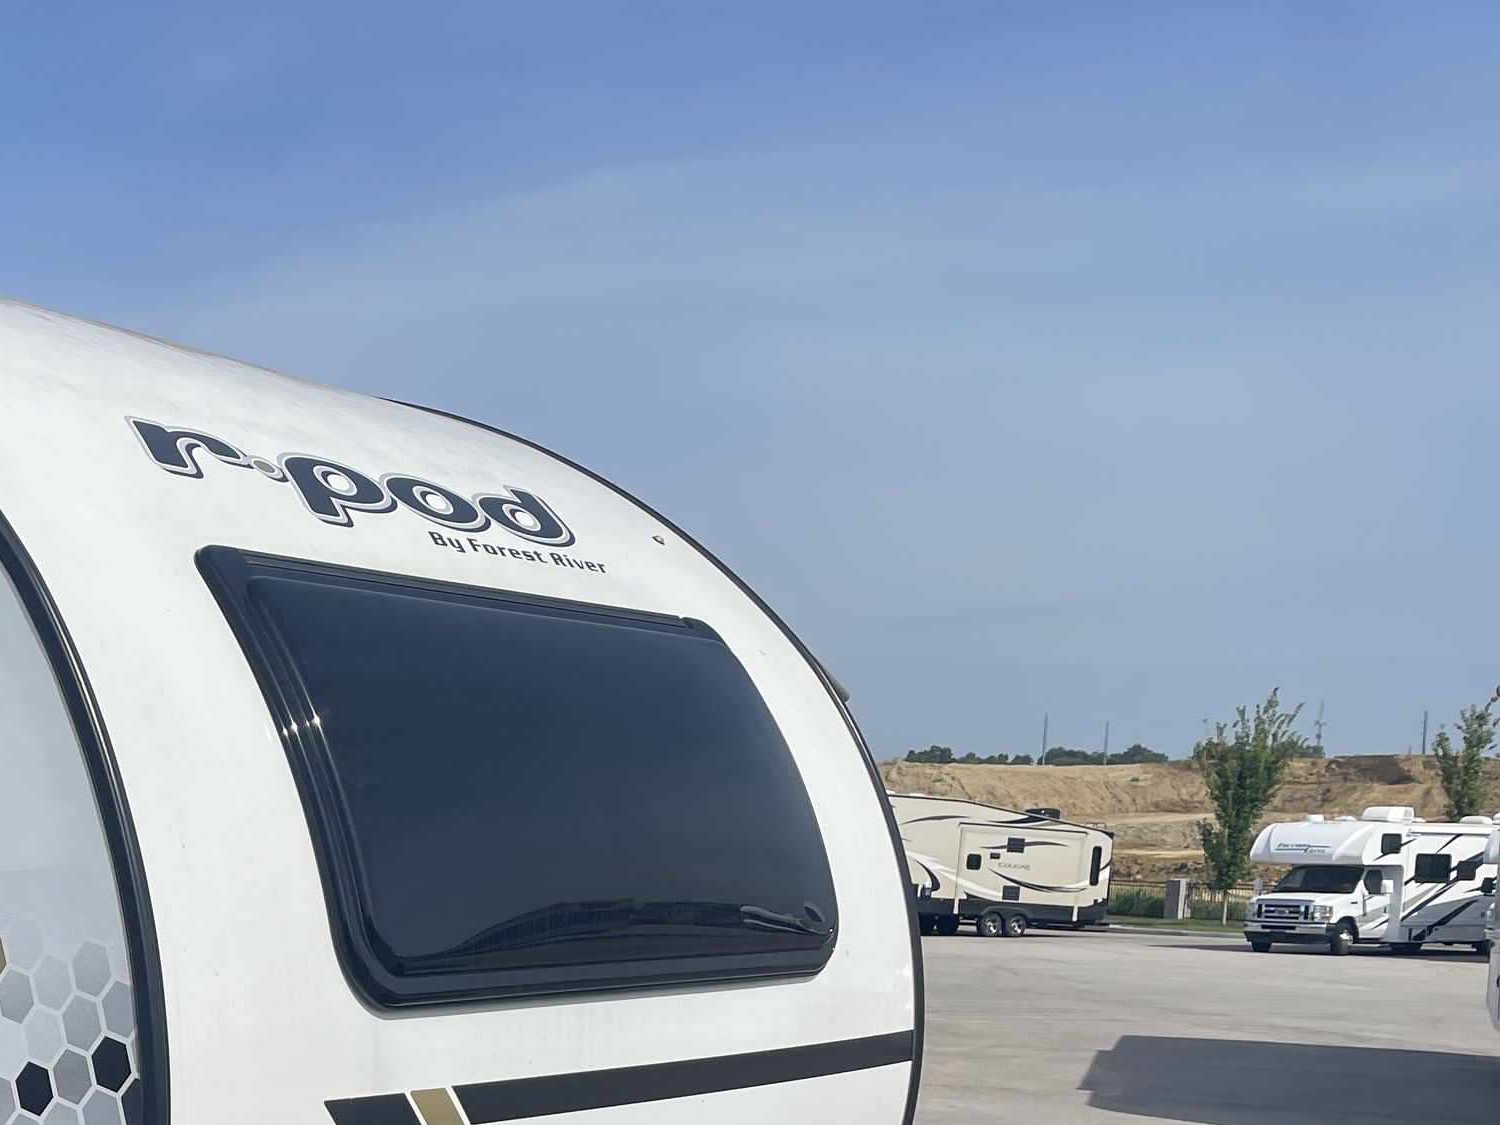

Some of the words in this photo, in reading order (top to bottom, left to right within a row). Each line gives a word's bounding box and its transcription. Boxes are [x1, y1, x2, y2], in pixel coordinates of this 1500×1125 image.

[428, 531, 466, 553] By
[467, 537, 548, 564] Forest
[550, 552, 607, 573] River
